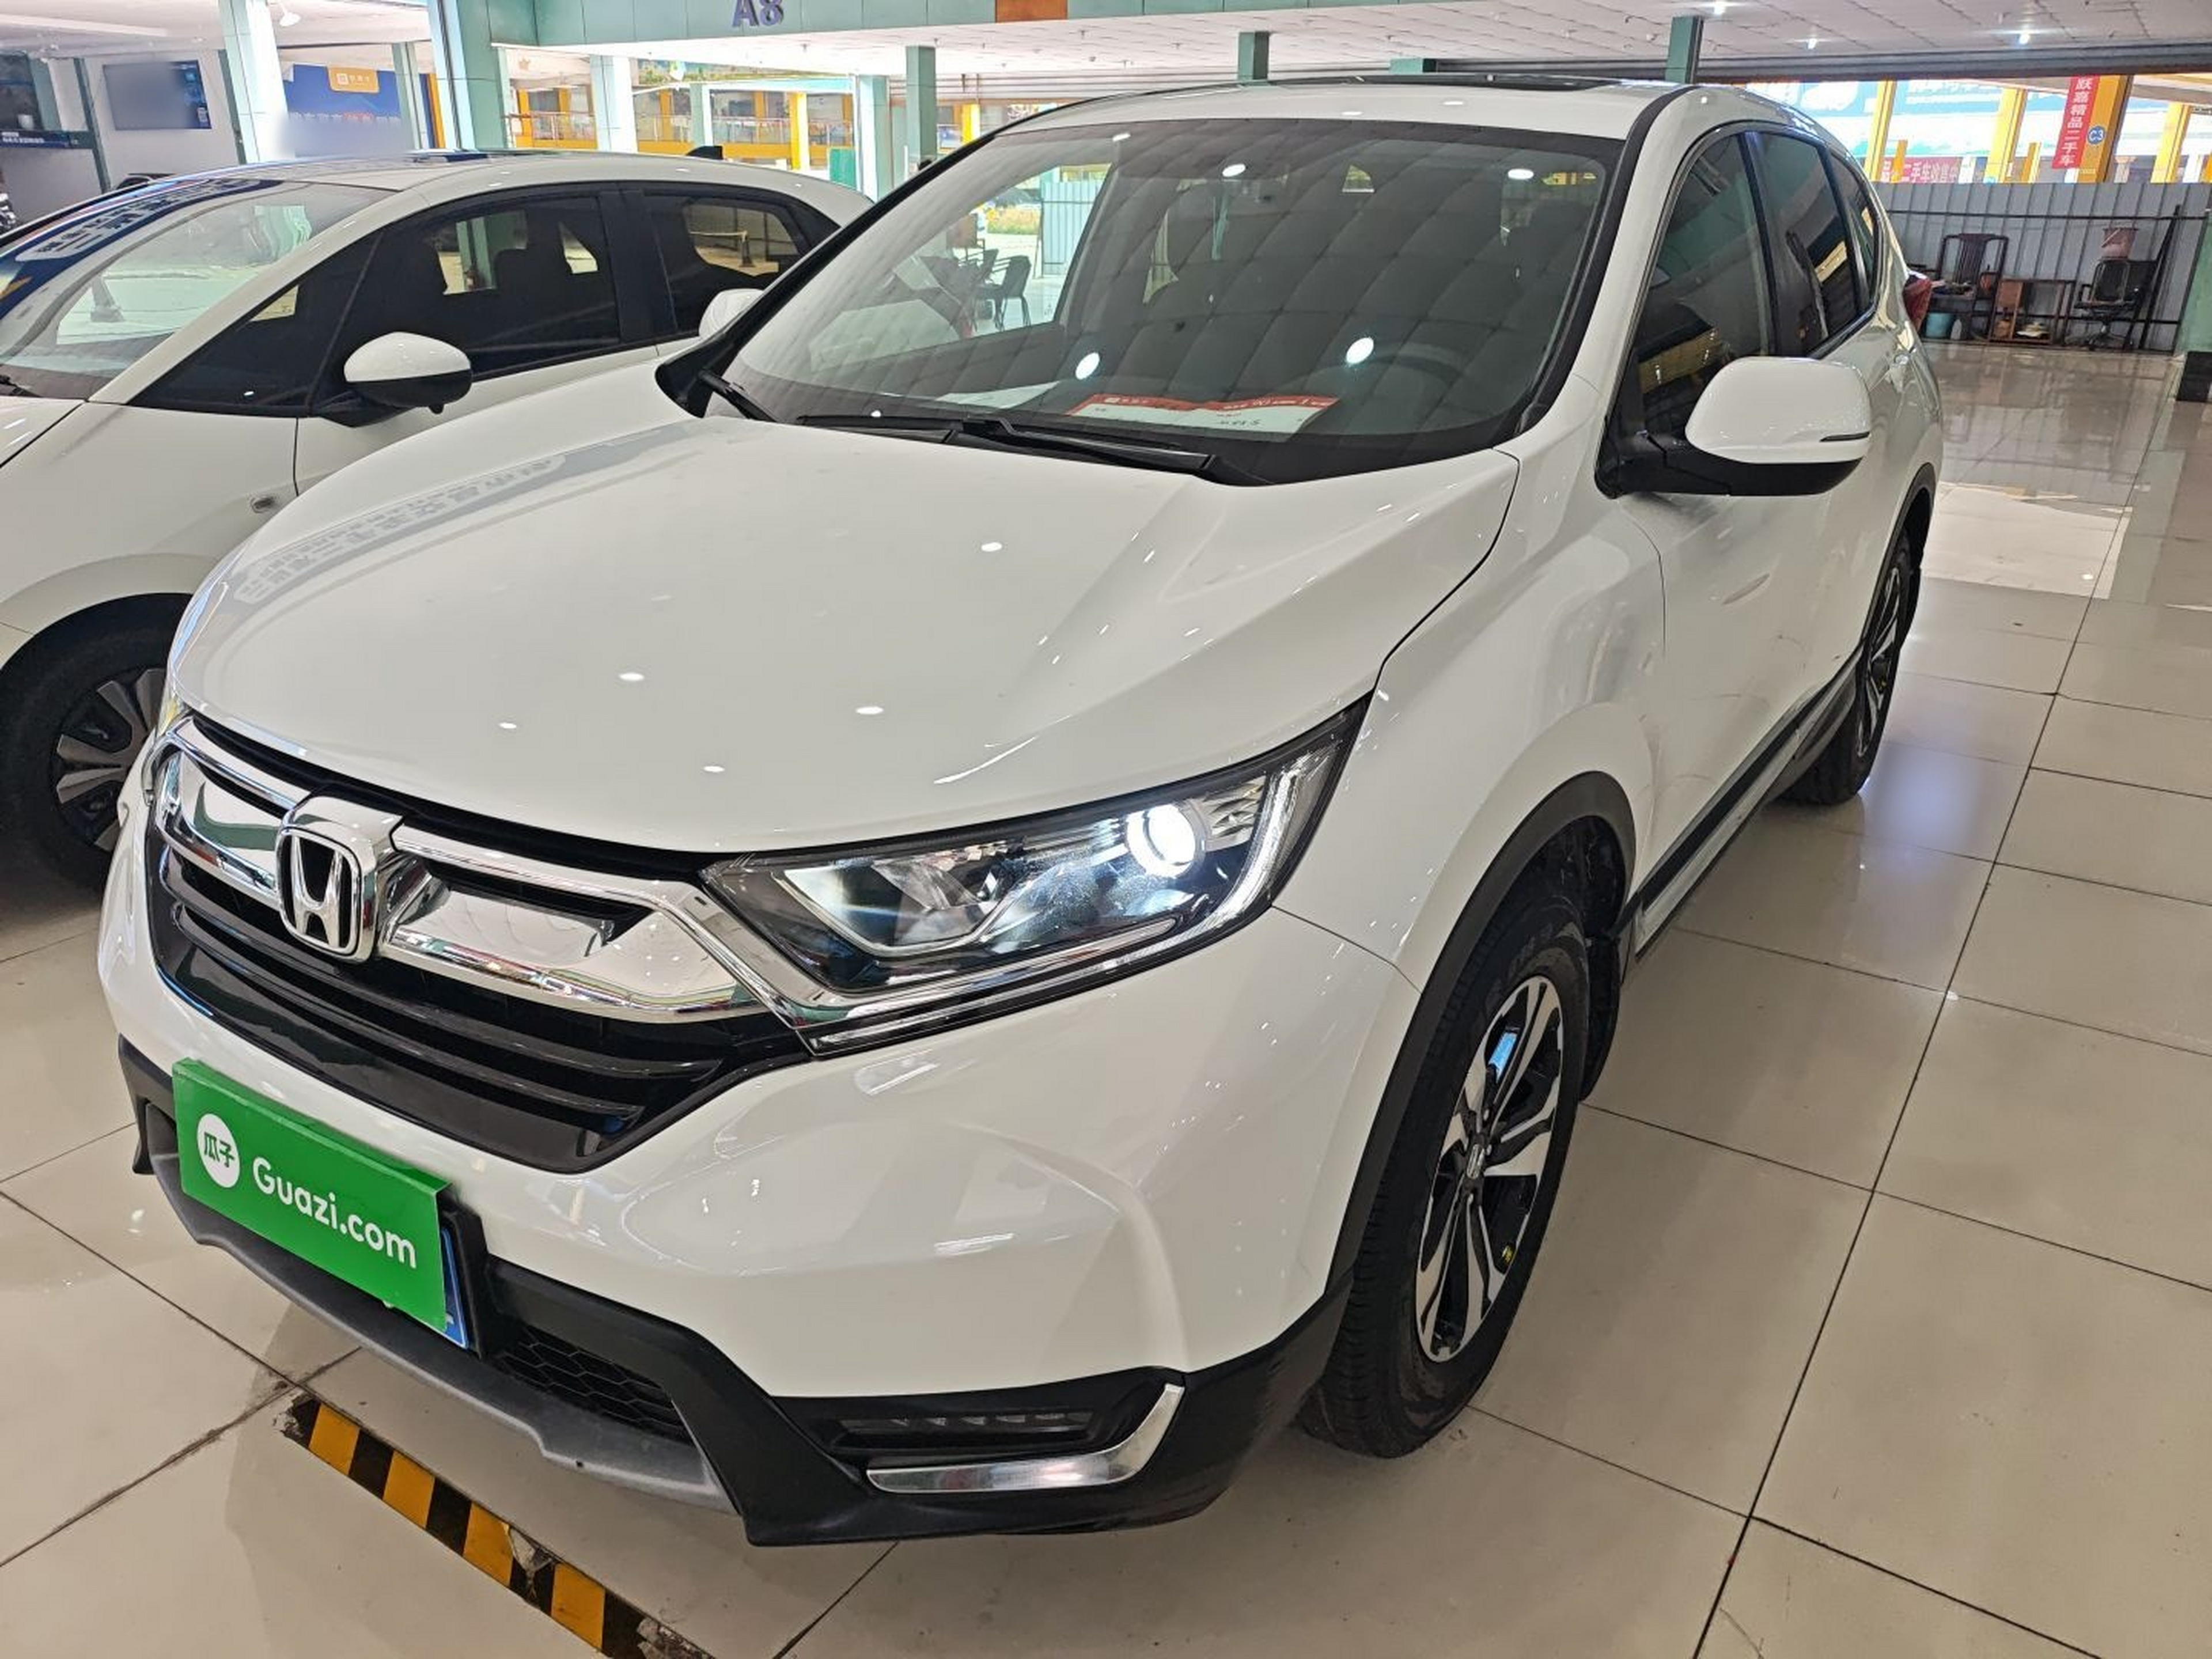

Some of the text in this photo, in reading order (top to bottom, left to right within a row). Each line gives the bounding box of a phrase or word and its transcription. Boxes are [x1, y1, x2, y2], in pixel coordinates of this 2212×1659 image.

[732, 0, 783, 26] A8
[2088, 128, 2104, 143] C3
[204, 1131, 235, 1168] 瓜子
[252, 1157, 417, 1269] Guazi.com
